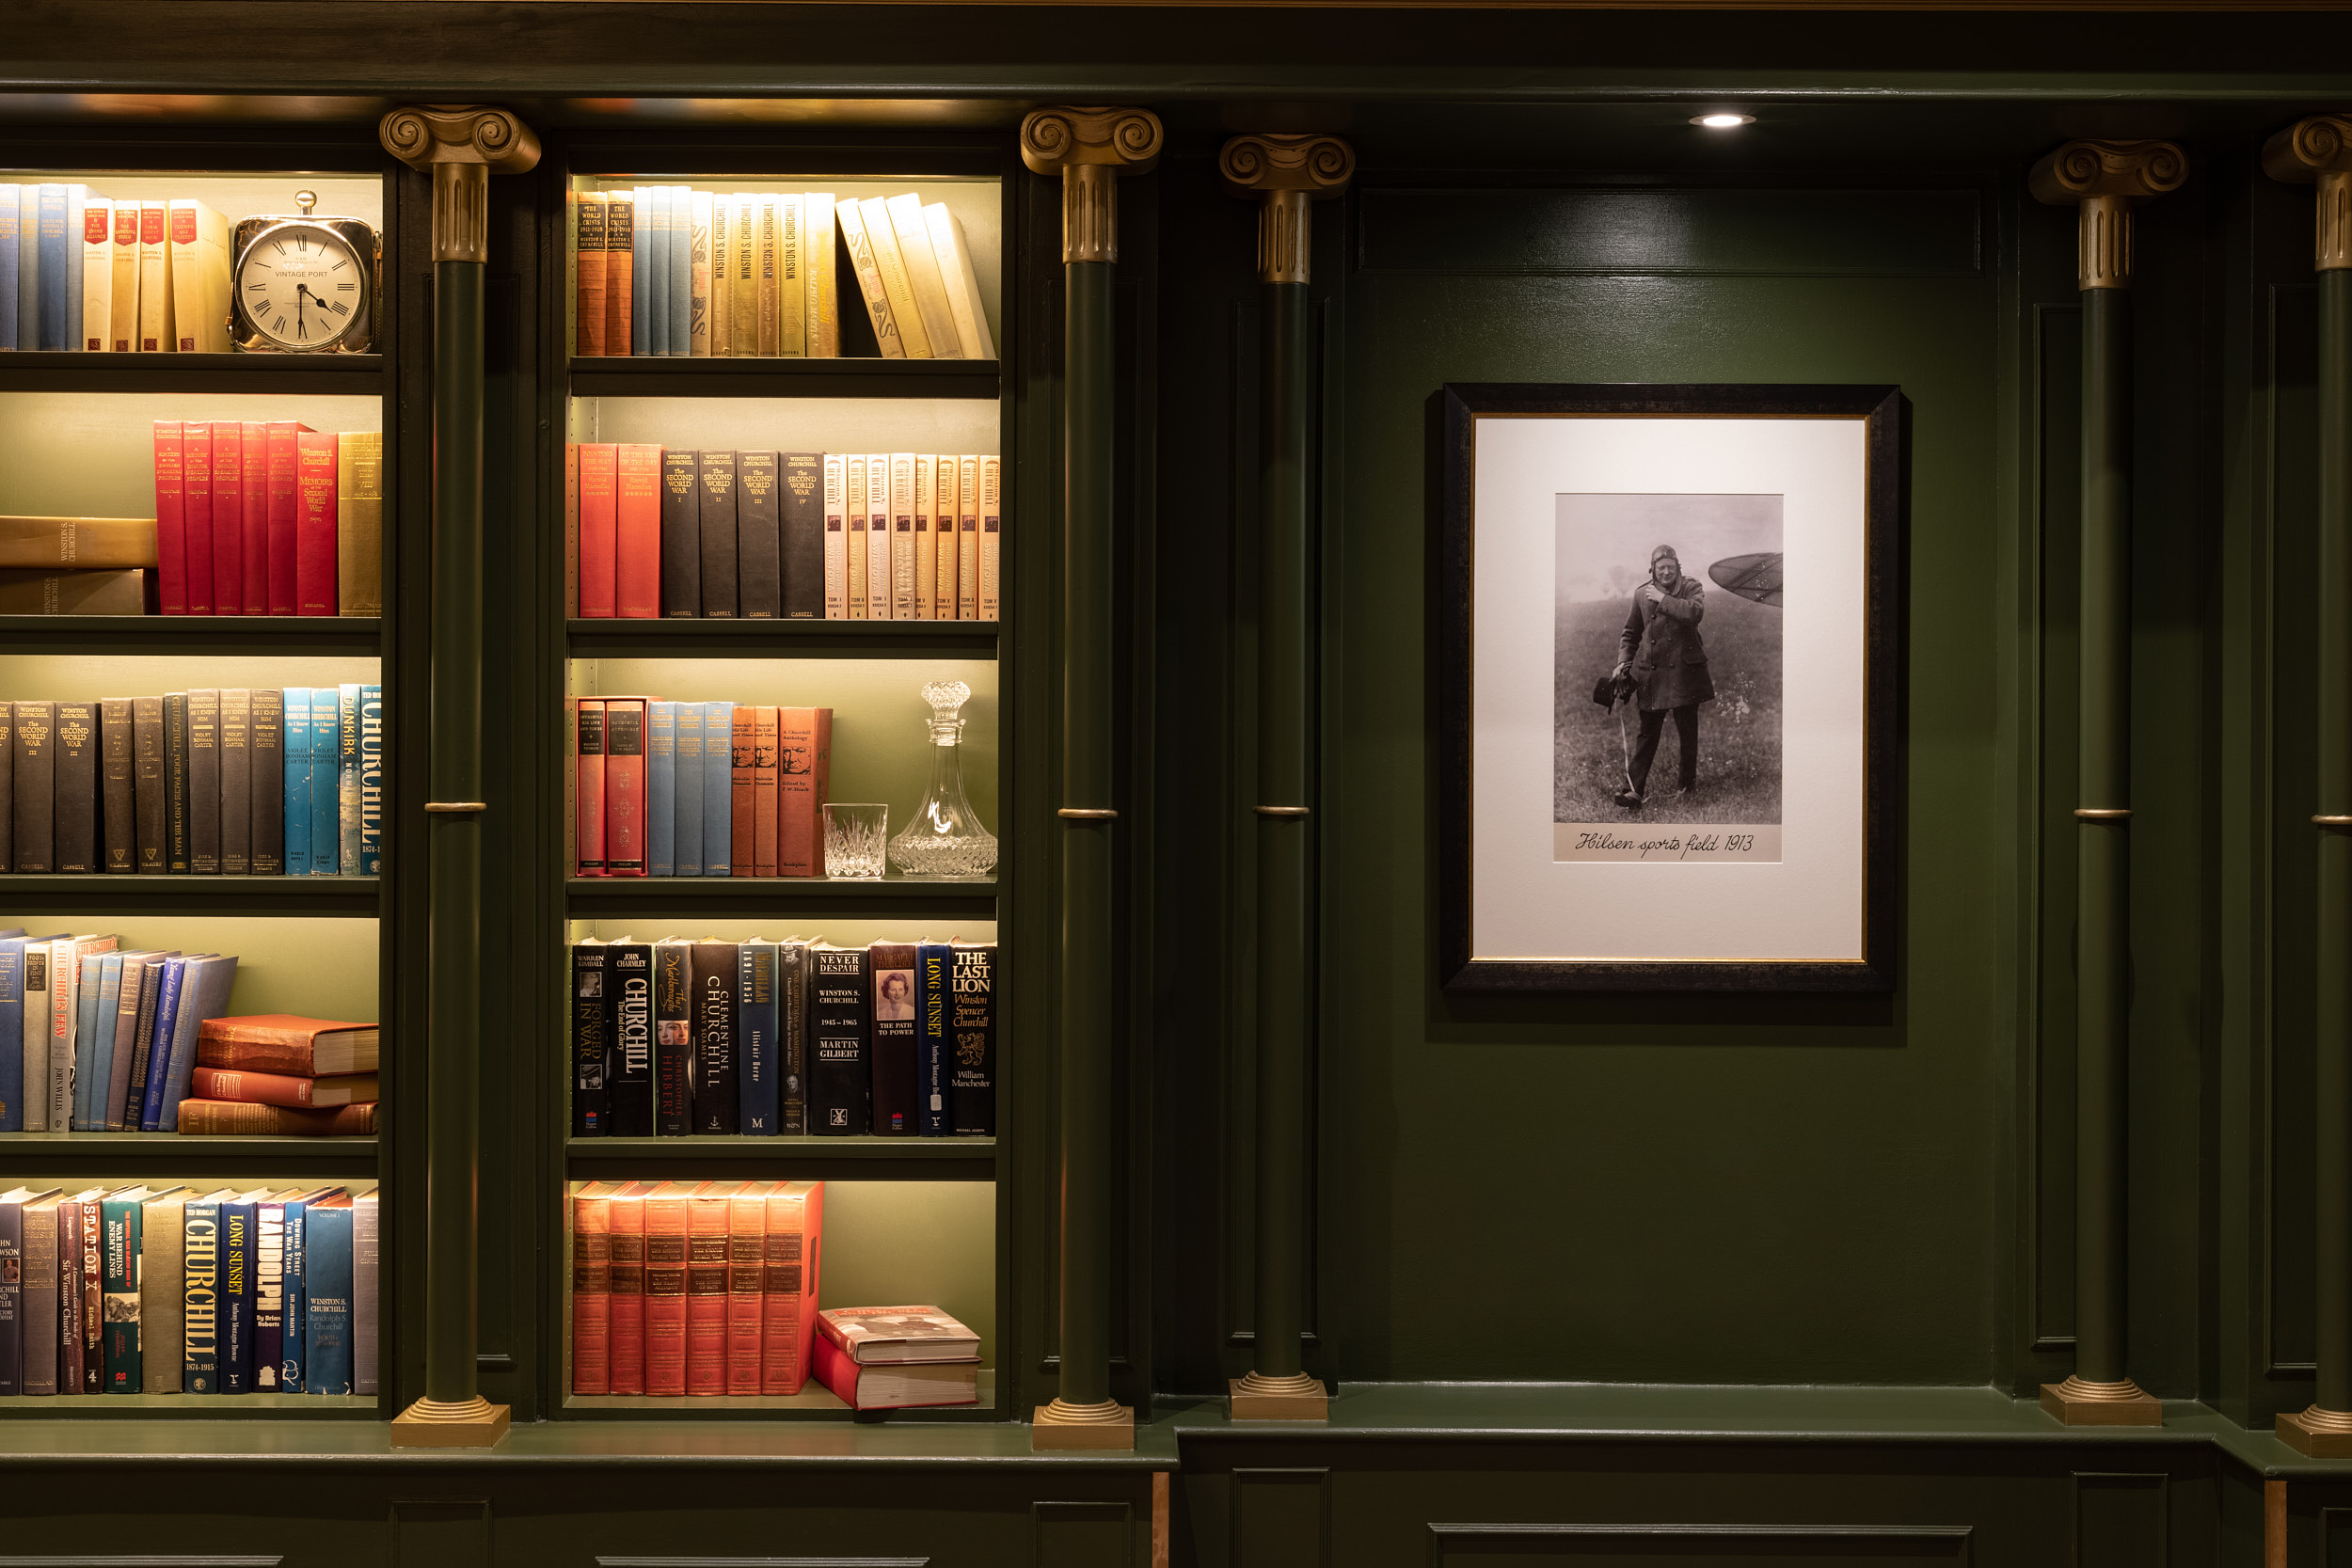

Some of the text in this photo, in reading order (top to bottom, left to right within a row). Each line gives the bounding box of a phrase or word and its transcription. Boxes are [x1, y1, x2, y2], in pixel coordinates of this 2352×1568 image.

[716, 204, 726, 239] CHURCHILL
[741, 203, 751, 239] CHURCHILL
[715, 249, 725, 279] WINSTON
[741, 249, 751, 279] WINSTON
[173, 697, 181, 751] CHURCHILL,
[343, 696, 355, 755] DUNKIRK
[362, 702, 381, 844] CHURCHILL
[1575, 833, 1754, 860] Hilsen sports field 1913
[659, 953, 682, 1012] Marlboroughs
[820, 956, 859, 964] NEVER
[953, 966, 990, 978] LAST
[955, 952, 987, 965] THE
[55, 946, 68, 1039] CHURCHILL'S FEW
[162, 962, 178, 1021] Young Lady Randolph
[675, 989, 687, 1005] The
[927, 958, 941, 1037] LONG SUNSET
[952, 980, 990, 993] LION
[954, 994, 987, 1004] Winston
[956, 1006, 986, 1018] Spencer
[580, 1003, 591, 1060] IN WAR
[591, 1003, 602, 1059] FORGED
[625, 978, 647, 1074] CHURCHILL
[708, 976, 720, 1087] CHURCHILL
[720, 991, 729, 1070] CLEMENTINE
[953, 1017, 988, 1027] Churchill
[55, 1067, 63, 1085] JOHN
[663, 1056, 673, 1117] HIBBERT
[952, 1079, 990, 1087] Manchester
[84, 1206, 97, 1290] STATION X
[229, 1215, 244, 1295] LONG SUNSET
[257, 1209, 284, 1310] RANDOLPH
[186, 1219, 216, 1361] CHURCHILL
[63, 1309, 71, 1345] Churchill
